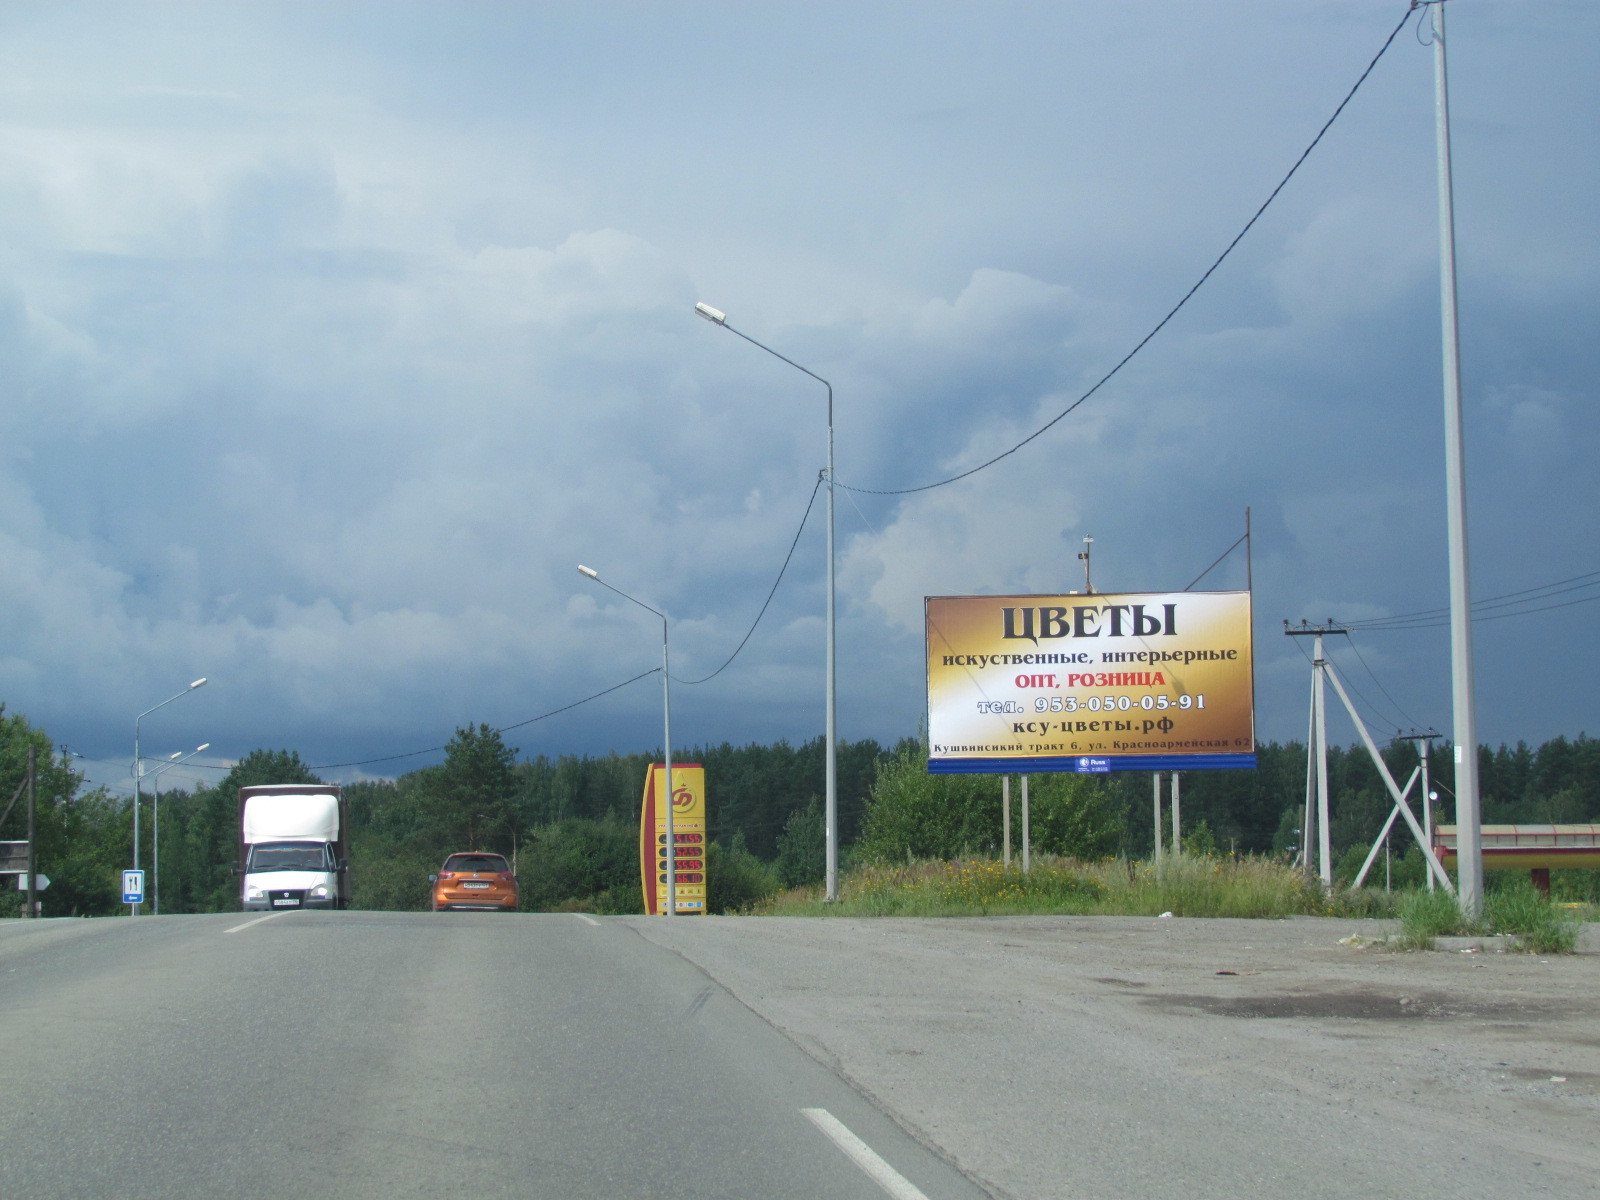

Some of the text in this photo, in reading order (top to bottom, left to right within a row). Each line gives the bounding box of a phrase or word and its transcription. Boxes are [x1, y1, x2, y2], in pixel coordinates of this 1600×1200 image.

[1001, 603, 1178, 648] ЦВЕТЫ
[942, 649, 1238, 669] искуственные, интерьерные
[1014, 671, 1167, 689] ОПТ, РОЗНИЦА
[977, 694, 1206, 714] тел. 953-050-05-91
[1012, 716, 1175, 737] ксу-цветы.рф
[1028, 742, 1065, 752] тракт
[1088, 742, 1107, 751] ул.
[1113, 740, 1229, 750] Красноармейская
[1234, 738, 1250, 746] 62
